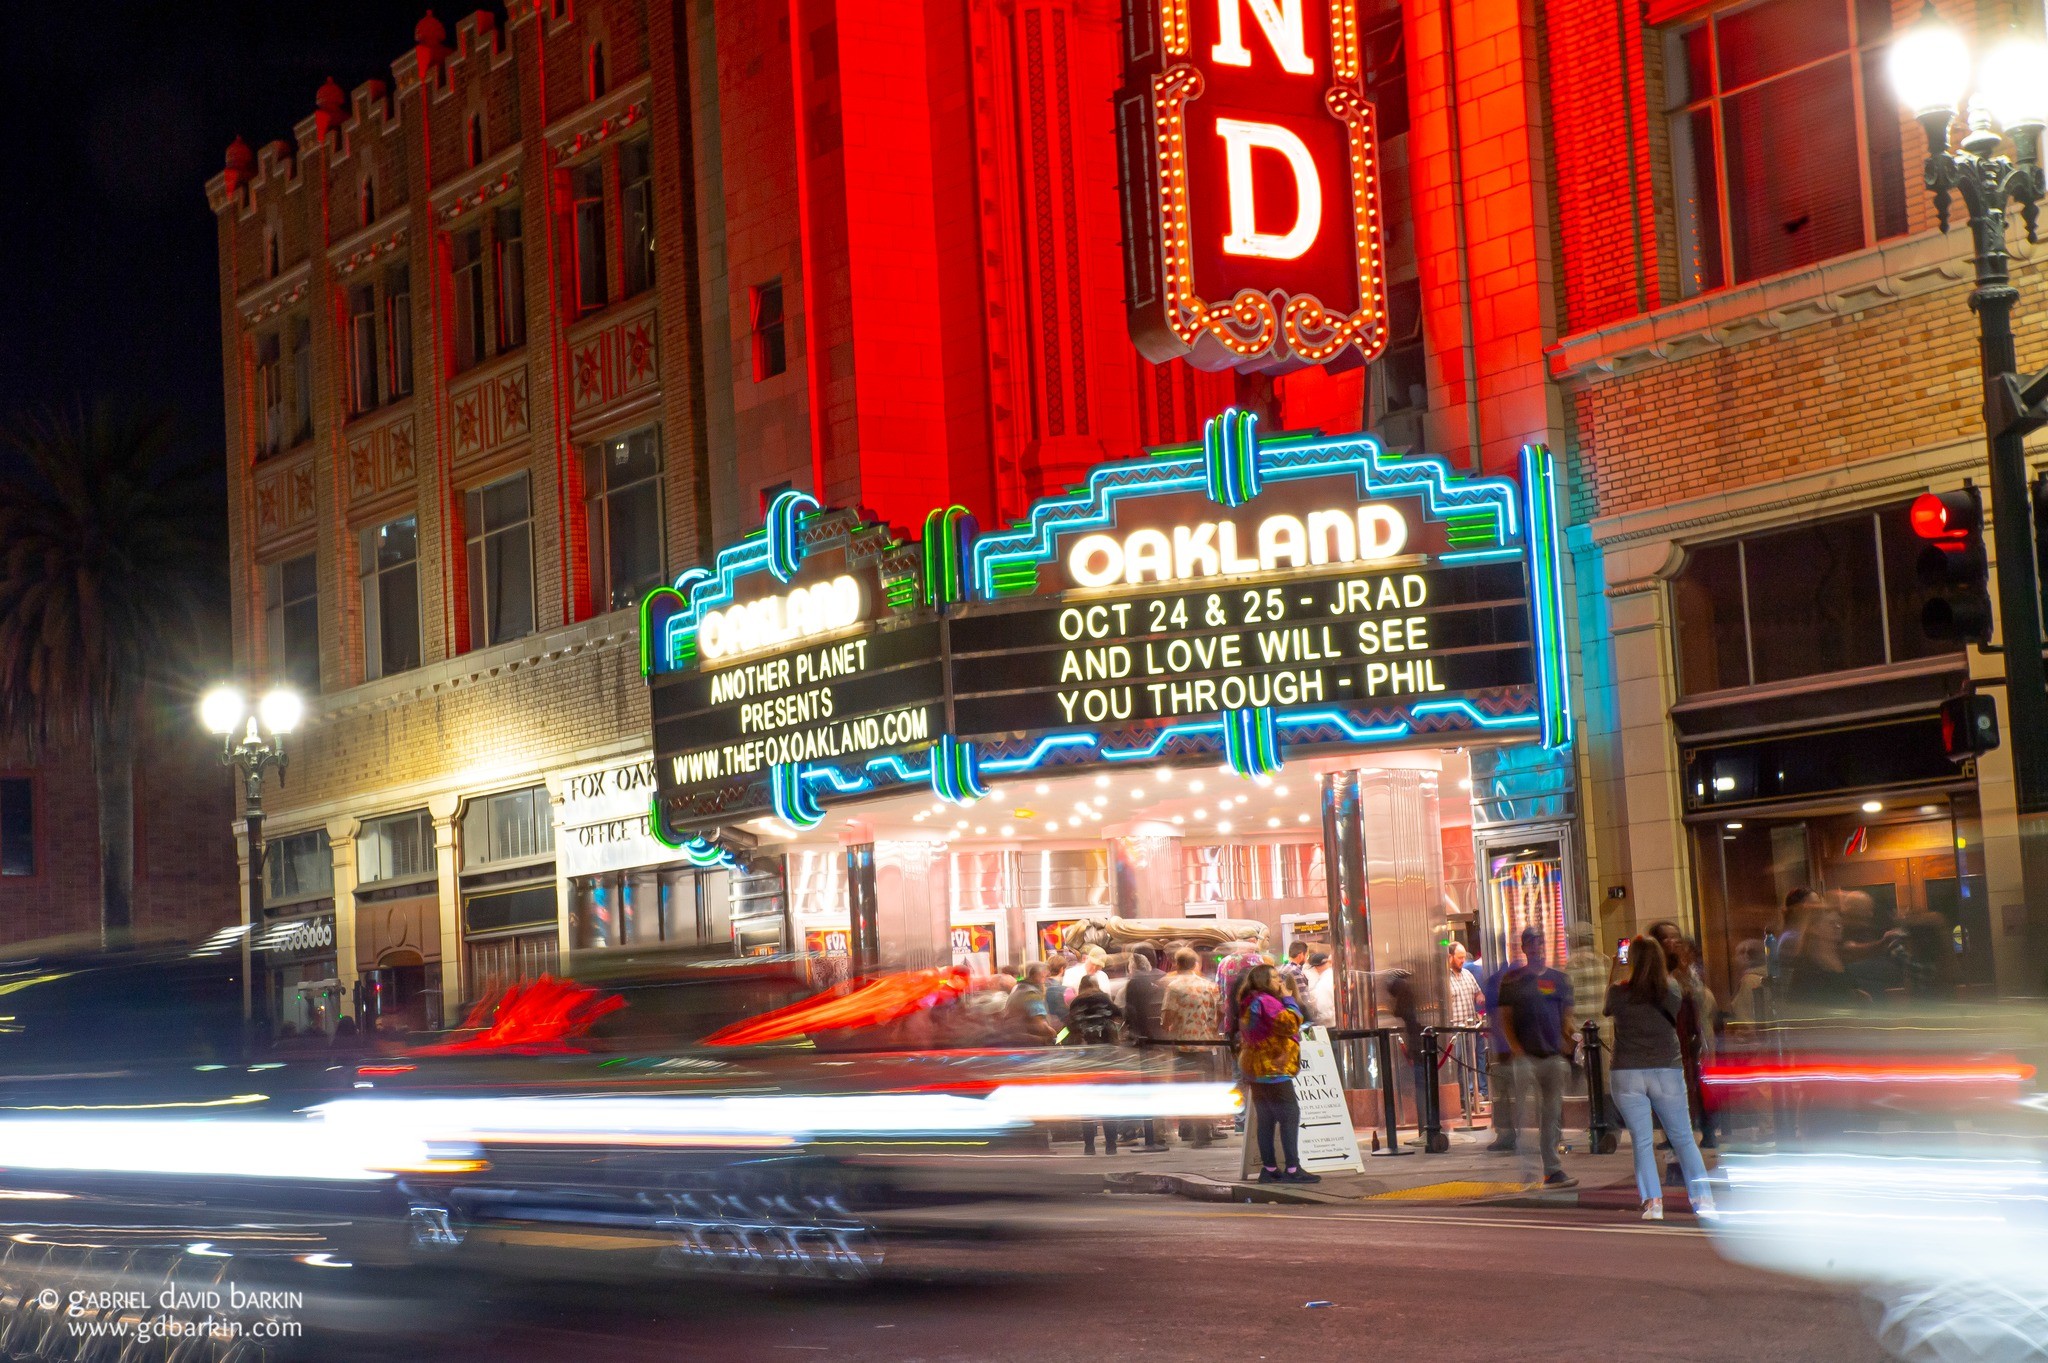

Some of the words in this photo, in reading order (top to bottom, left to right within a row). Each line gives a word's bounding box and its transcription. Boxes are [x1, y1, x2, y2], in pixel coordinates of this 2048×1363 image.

[1069, 504, 1408, 587] OAKLAND
[1059, 603, 1132, 641] OCT
[1149, 598, 1189, 633] 24
[1204, 594, 1227, 626] &
[1243, 588, 1285, 624] 25
[1329, 574, 1428, 616] JRAD
[711, 654, 791, 705] ANOTHER
[796, 640, 868, 685] PLANET
[1060, 645, 1132, 683] AND
[1146, 634, 1242, 675] LOVE
[1257, 626, 1342, 664] WILL
[1358, 616, 1430, 655] SEE
[741, 687, 834, 734] PRESENTS
[1057, 687, 1132, 724] YOU
[1146, 669, 1324, 715] THROUGH
[1366, 659, 1446, 697] PHIL
[672, 707, 929, 785] WWW.THEFOXOAKLAND.COM
[571, 770, 606, 802] FOX
[579, 820, 631, 848] OFFICE
[825, 931, 847, 950] FOX
[1293, 1074, 1328, 1088] VENT
